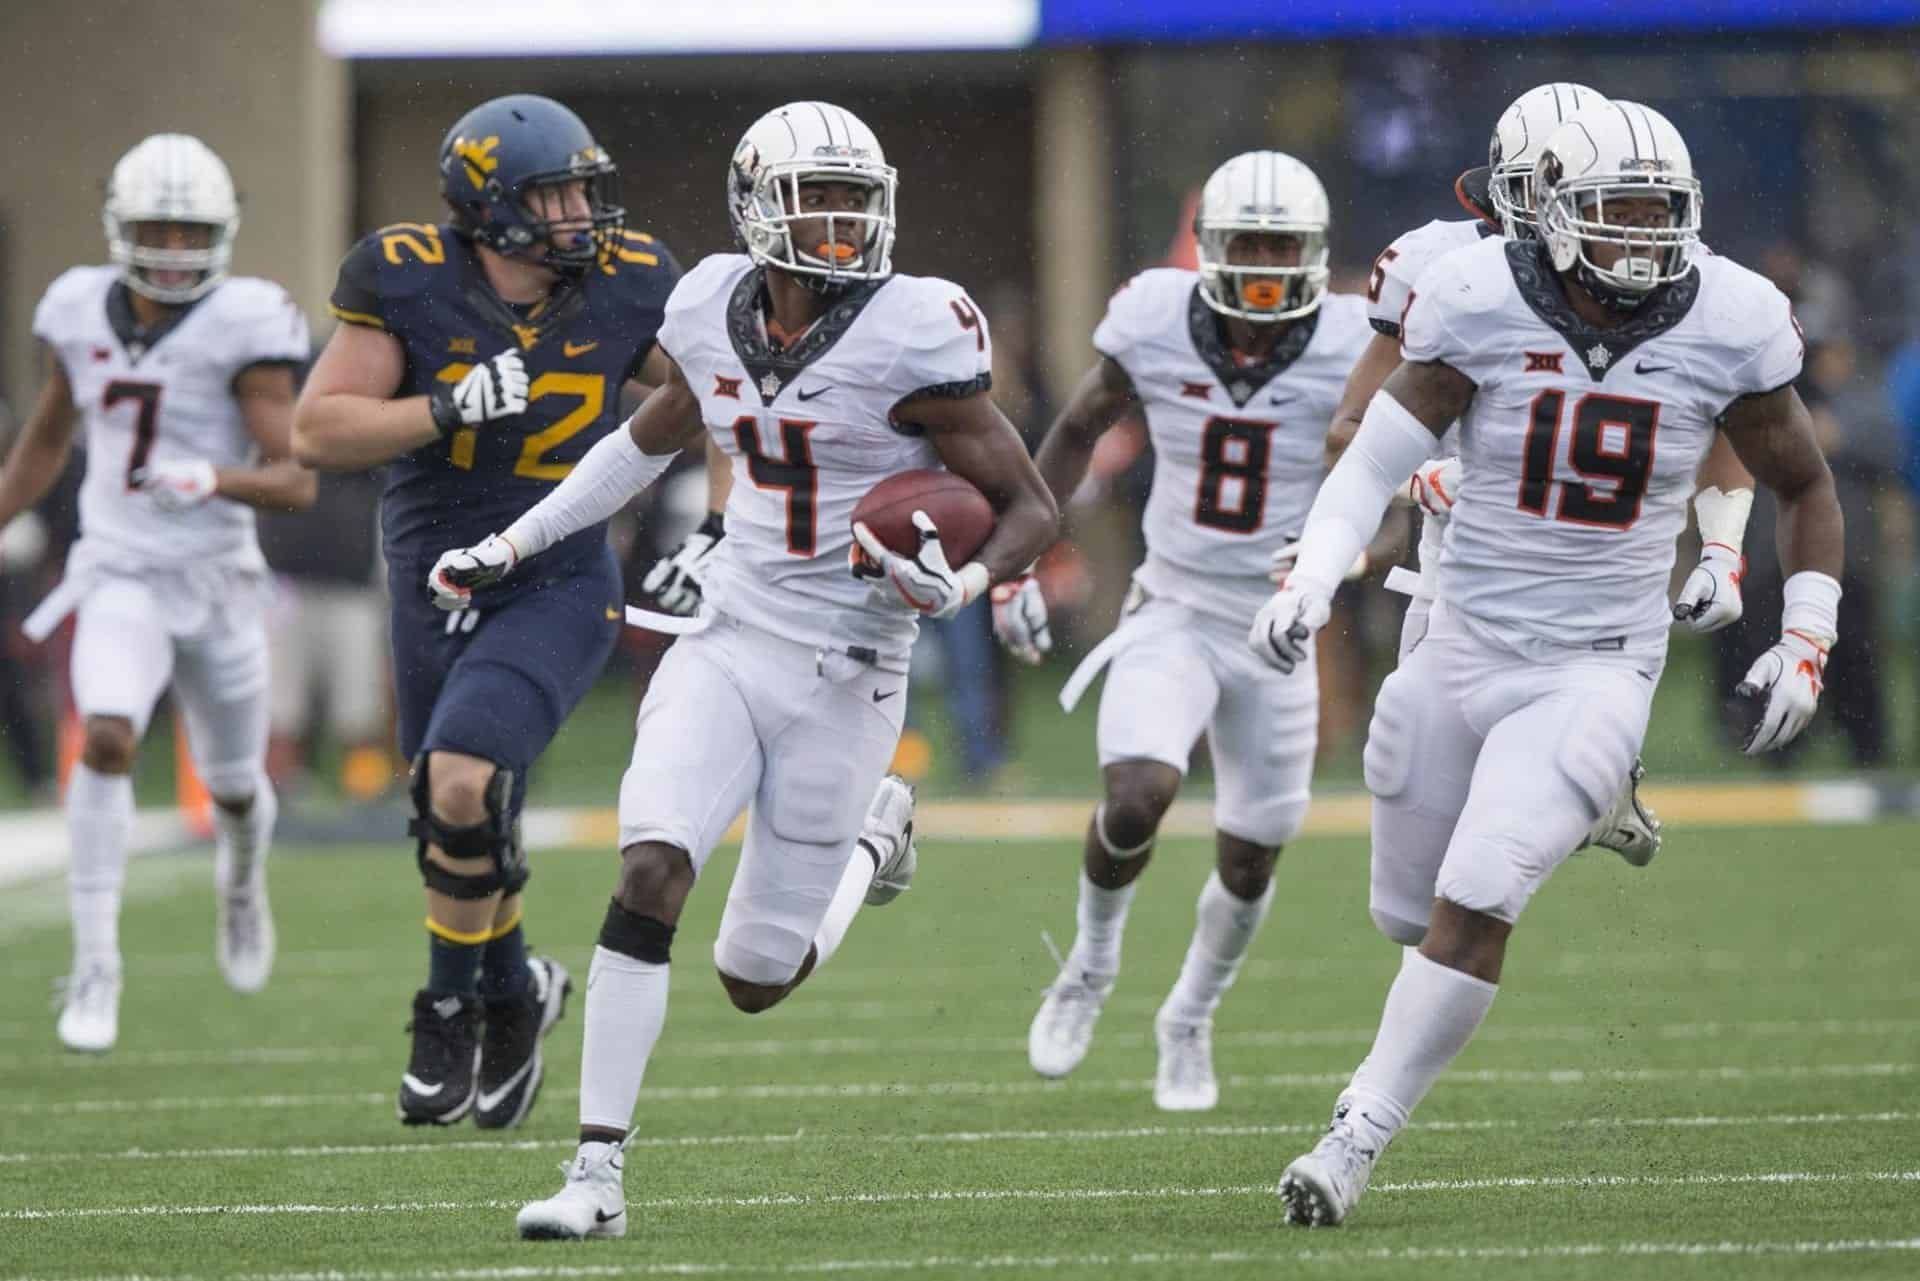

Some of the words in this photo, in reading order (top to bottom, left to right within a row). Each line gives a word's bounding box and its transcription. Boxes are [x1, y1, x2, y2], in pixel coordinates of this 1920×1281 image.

[949, 295, 985, 353] 4
[101, 378, 164, 494] 7
[732, 415, 819, 560] 4
[1193, 415, 1281, 536] 8
[1516, 387, 1662, 533] 19
